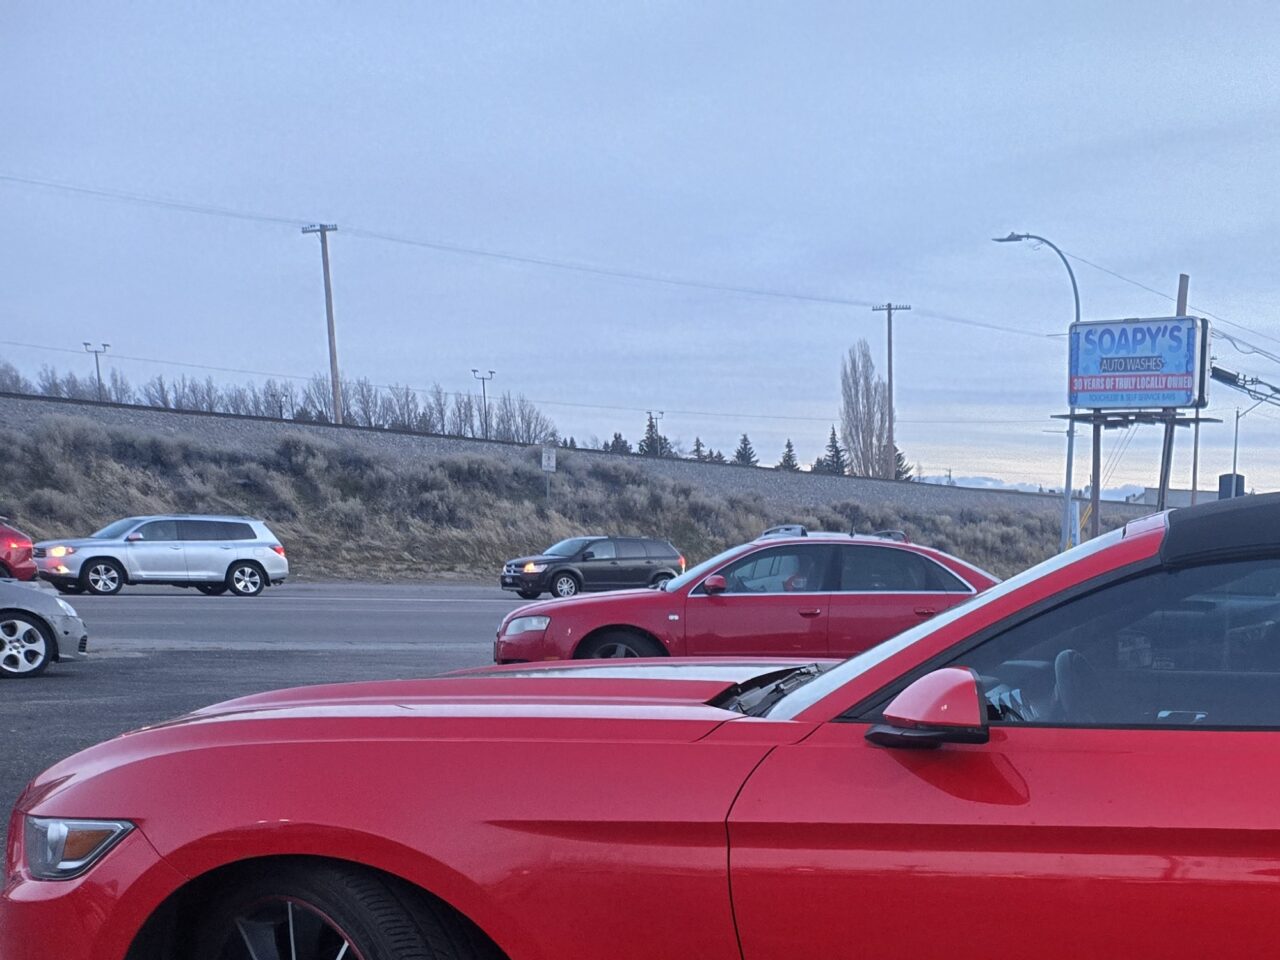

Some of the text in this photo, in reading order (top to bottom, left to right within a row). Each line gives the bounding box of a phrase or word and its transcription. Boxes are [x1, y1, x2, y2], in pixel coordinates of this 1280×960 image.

[1084, 325, 1182, 355] SOAPY'S
[1101, 357, 1163, 371] AUTO WASHES
[1083, 378, 1104, 390] YEARS
[1105, 378, 1115, 389] OF
[1115, 377, 1136, 389] TRULY
[1136, 376, 1167, 389] LOCALLY
[1167, 376, 1192, 388] OWNED
